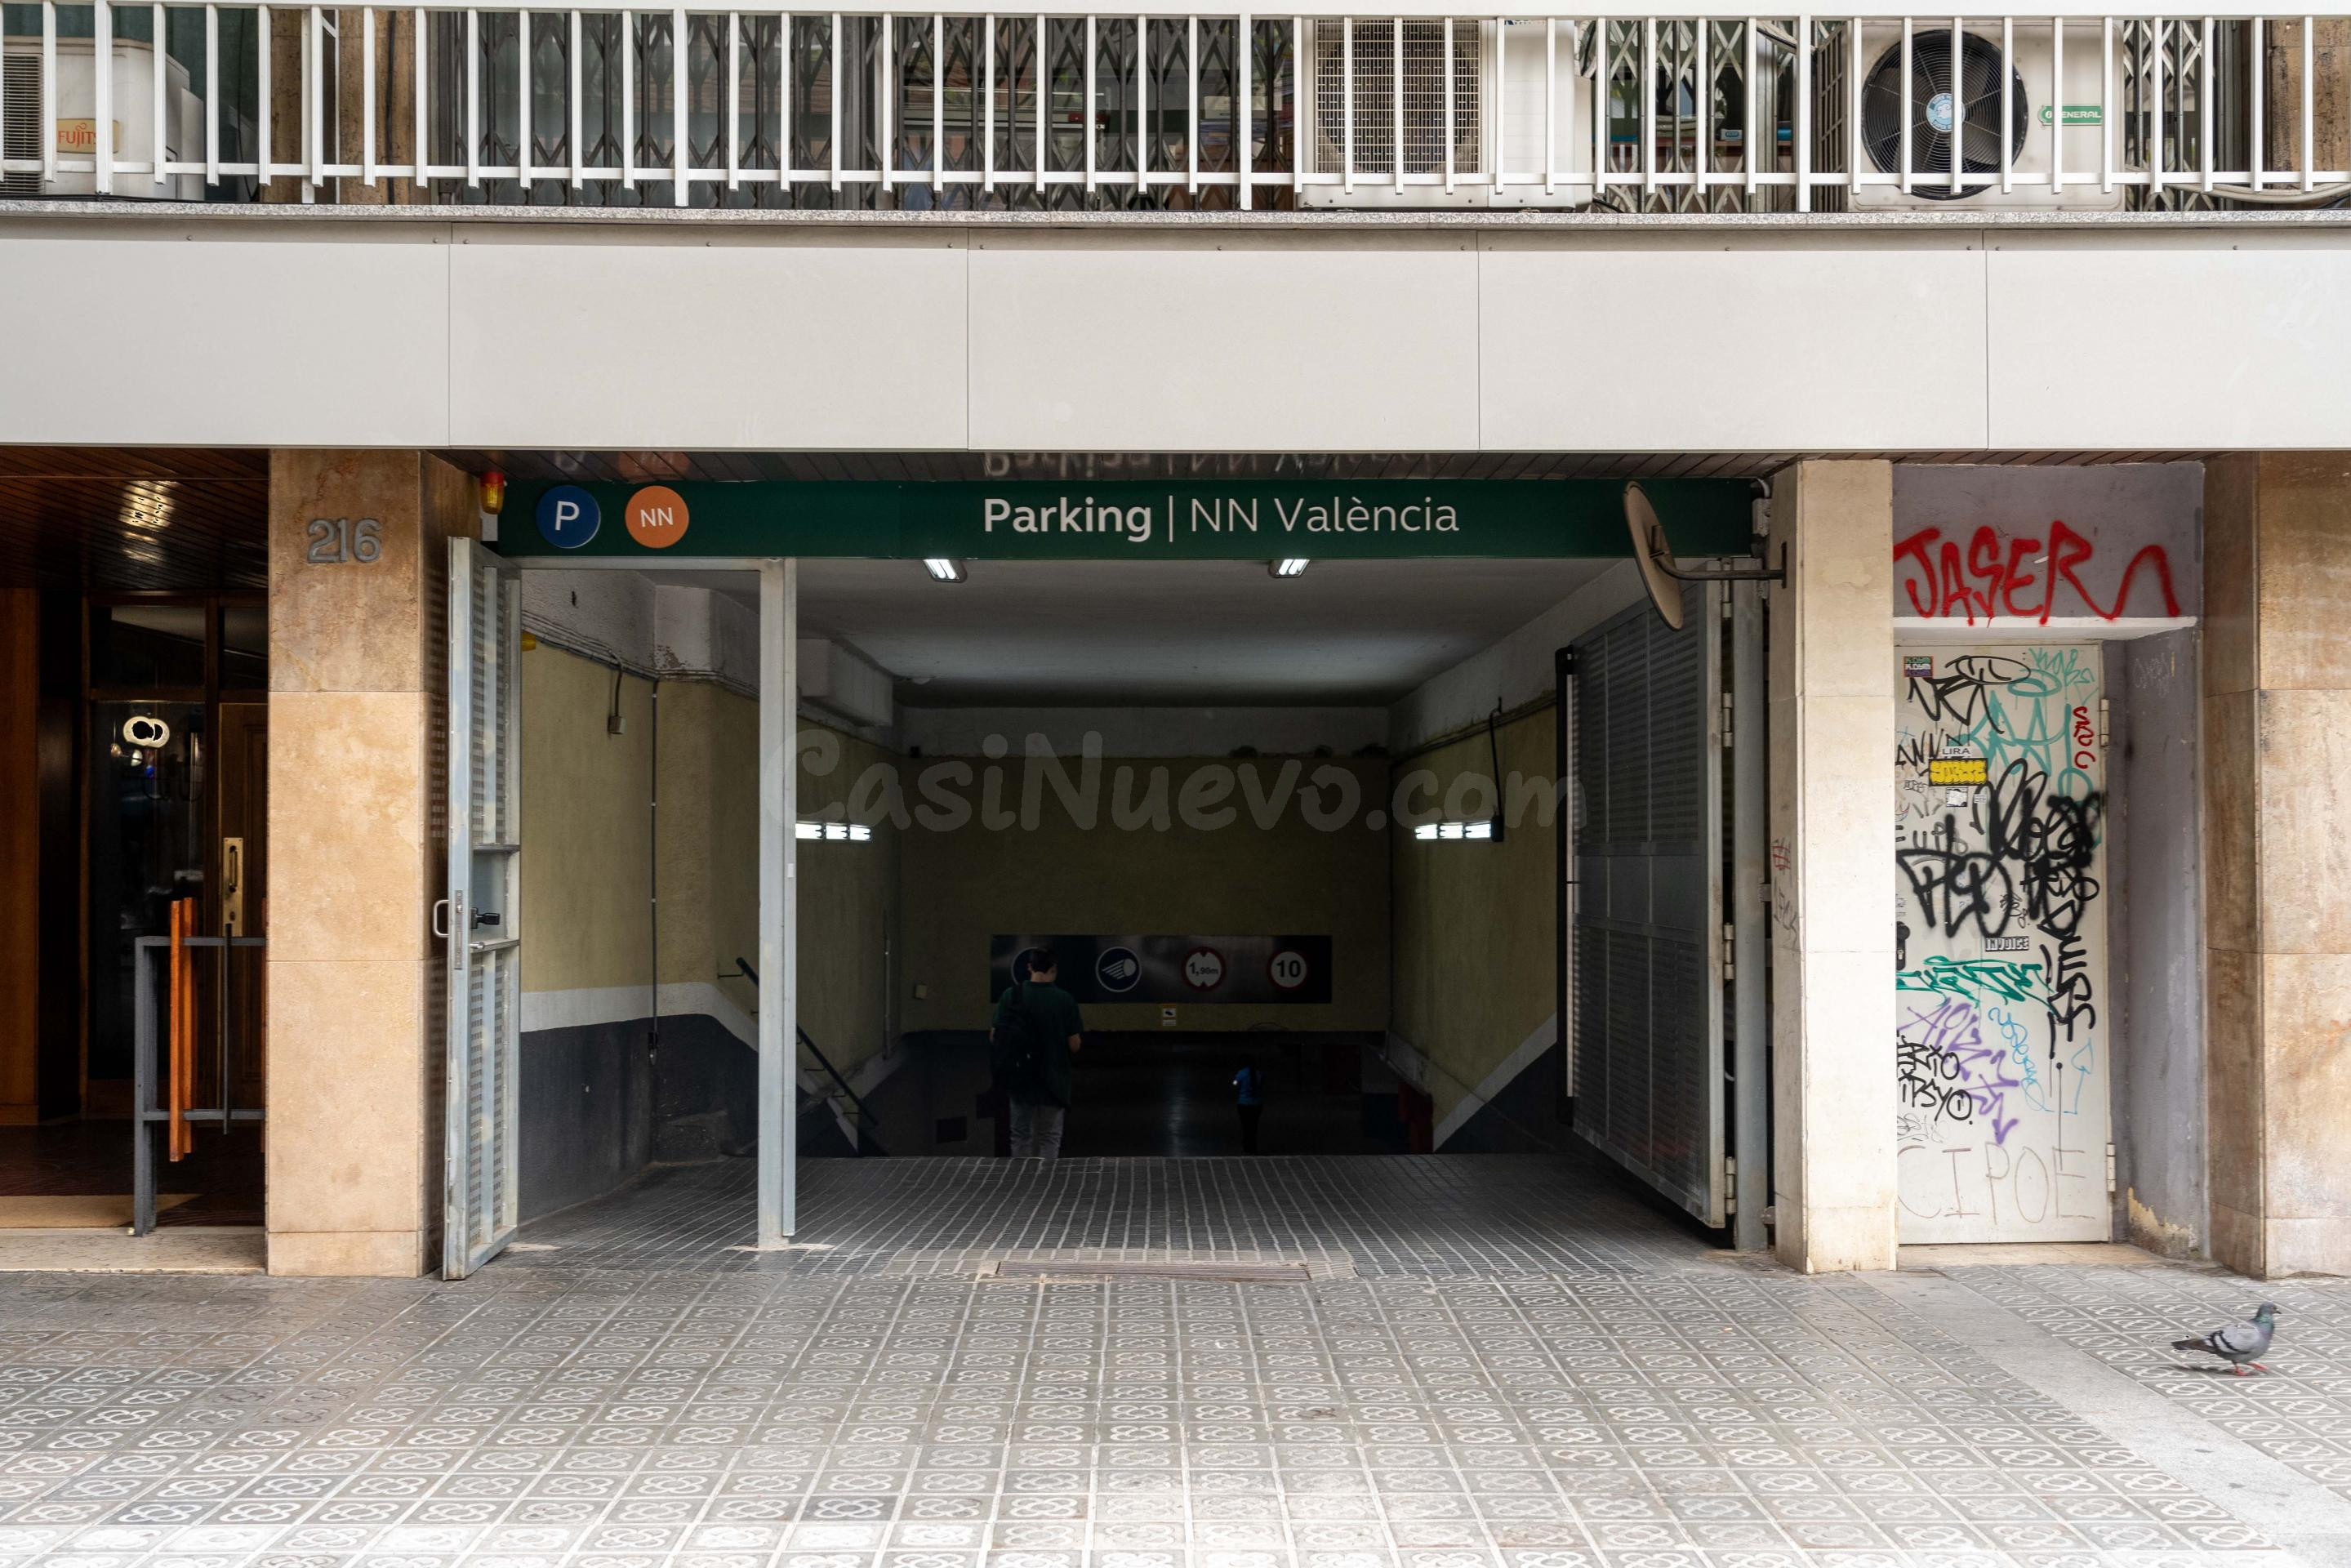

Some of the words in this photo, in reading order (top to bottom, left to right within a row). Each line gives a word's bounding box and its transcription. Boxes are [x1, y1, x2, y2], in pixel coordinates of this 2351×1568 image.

[57, 123, 96, 148] FUJIT
[554, 501, 581, 531] P
[639, 507, 674, 528] NN
[983, 496, 1152, 542] Parking
[1191, 498, 1258, 532] NN
[1274, 496, 1460, 532] València
[307, 517, 382, 564] 216
[1276, 960, 1302, 978] 10
